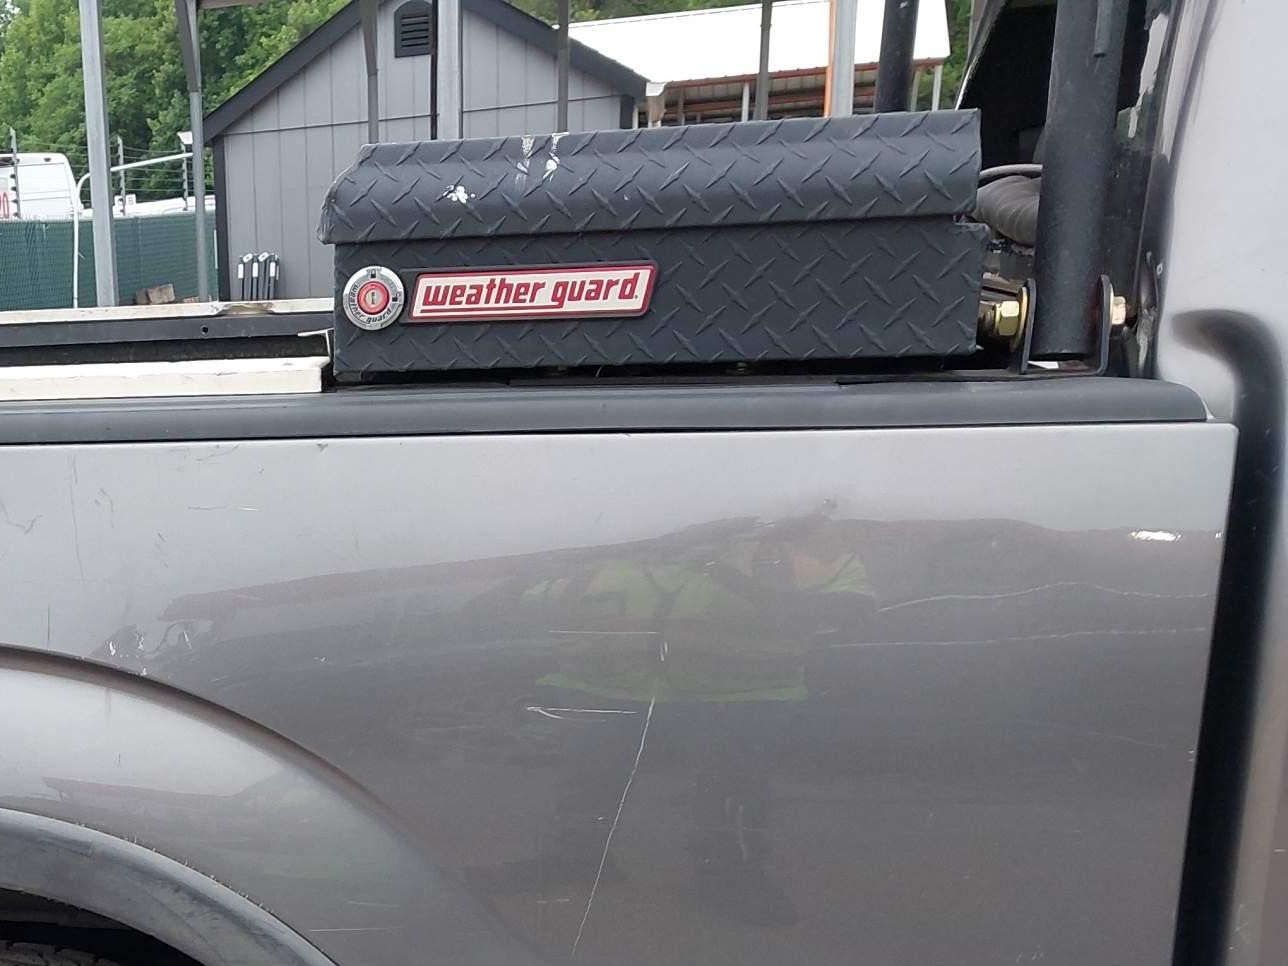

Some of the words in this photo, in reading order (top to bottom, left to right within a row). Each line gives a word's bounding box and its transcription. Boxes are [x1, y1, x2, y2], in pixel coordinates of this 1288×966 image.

[422, 278, 546, 306] weather
[550, 272, 640, 309] guard
[366, 307, 392, 325] guard
